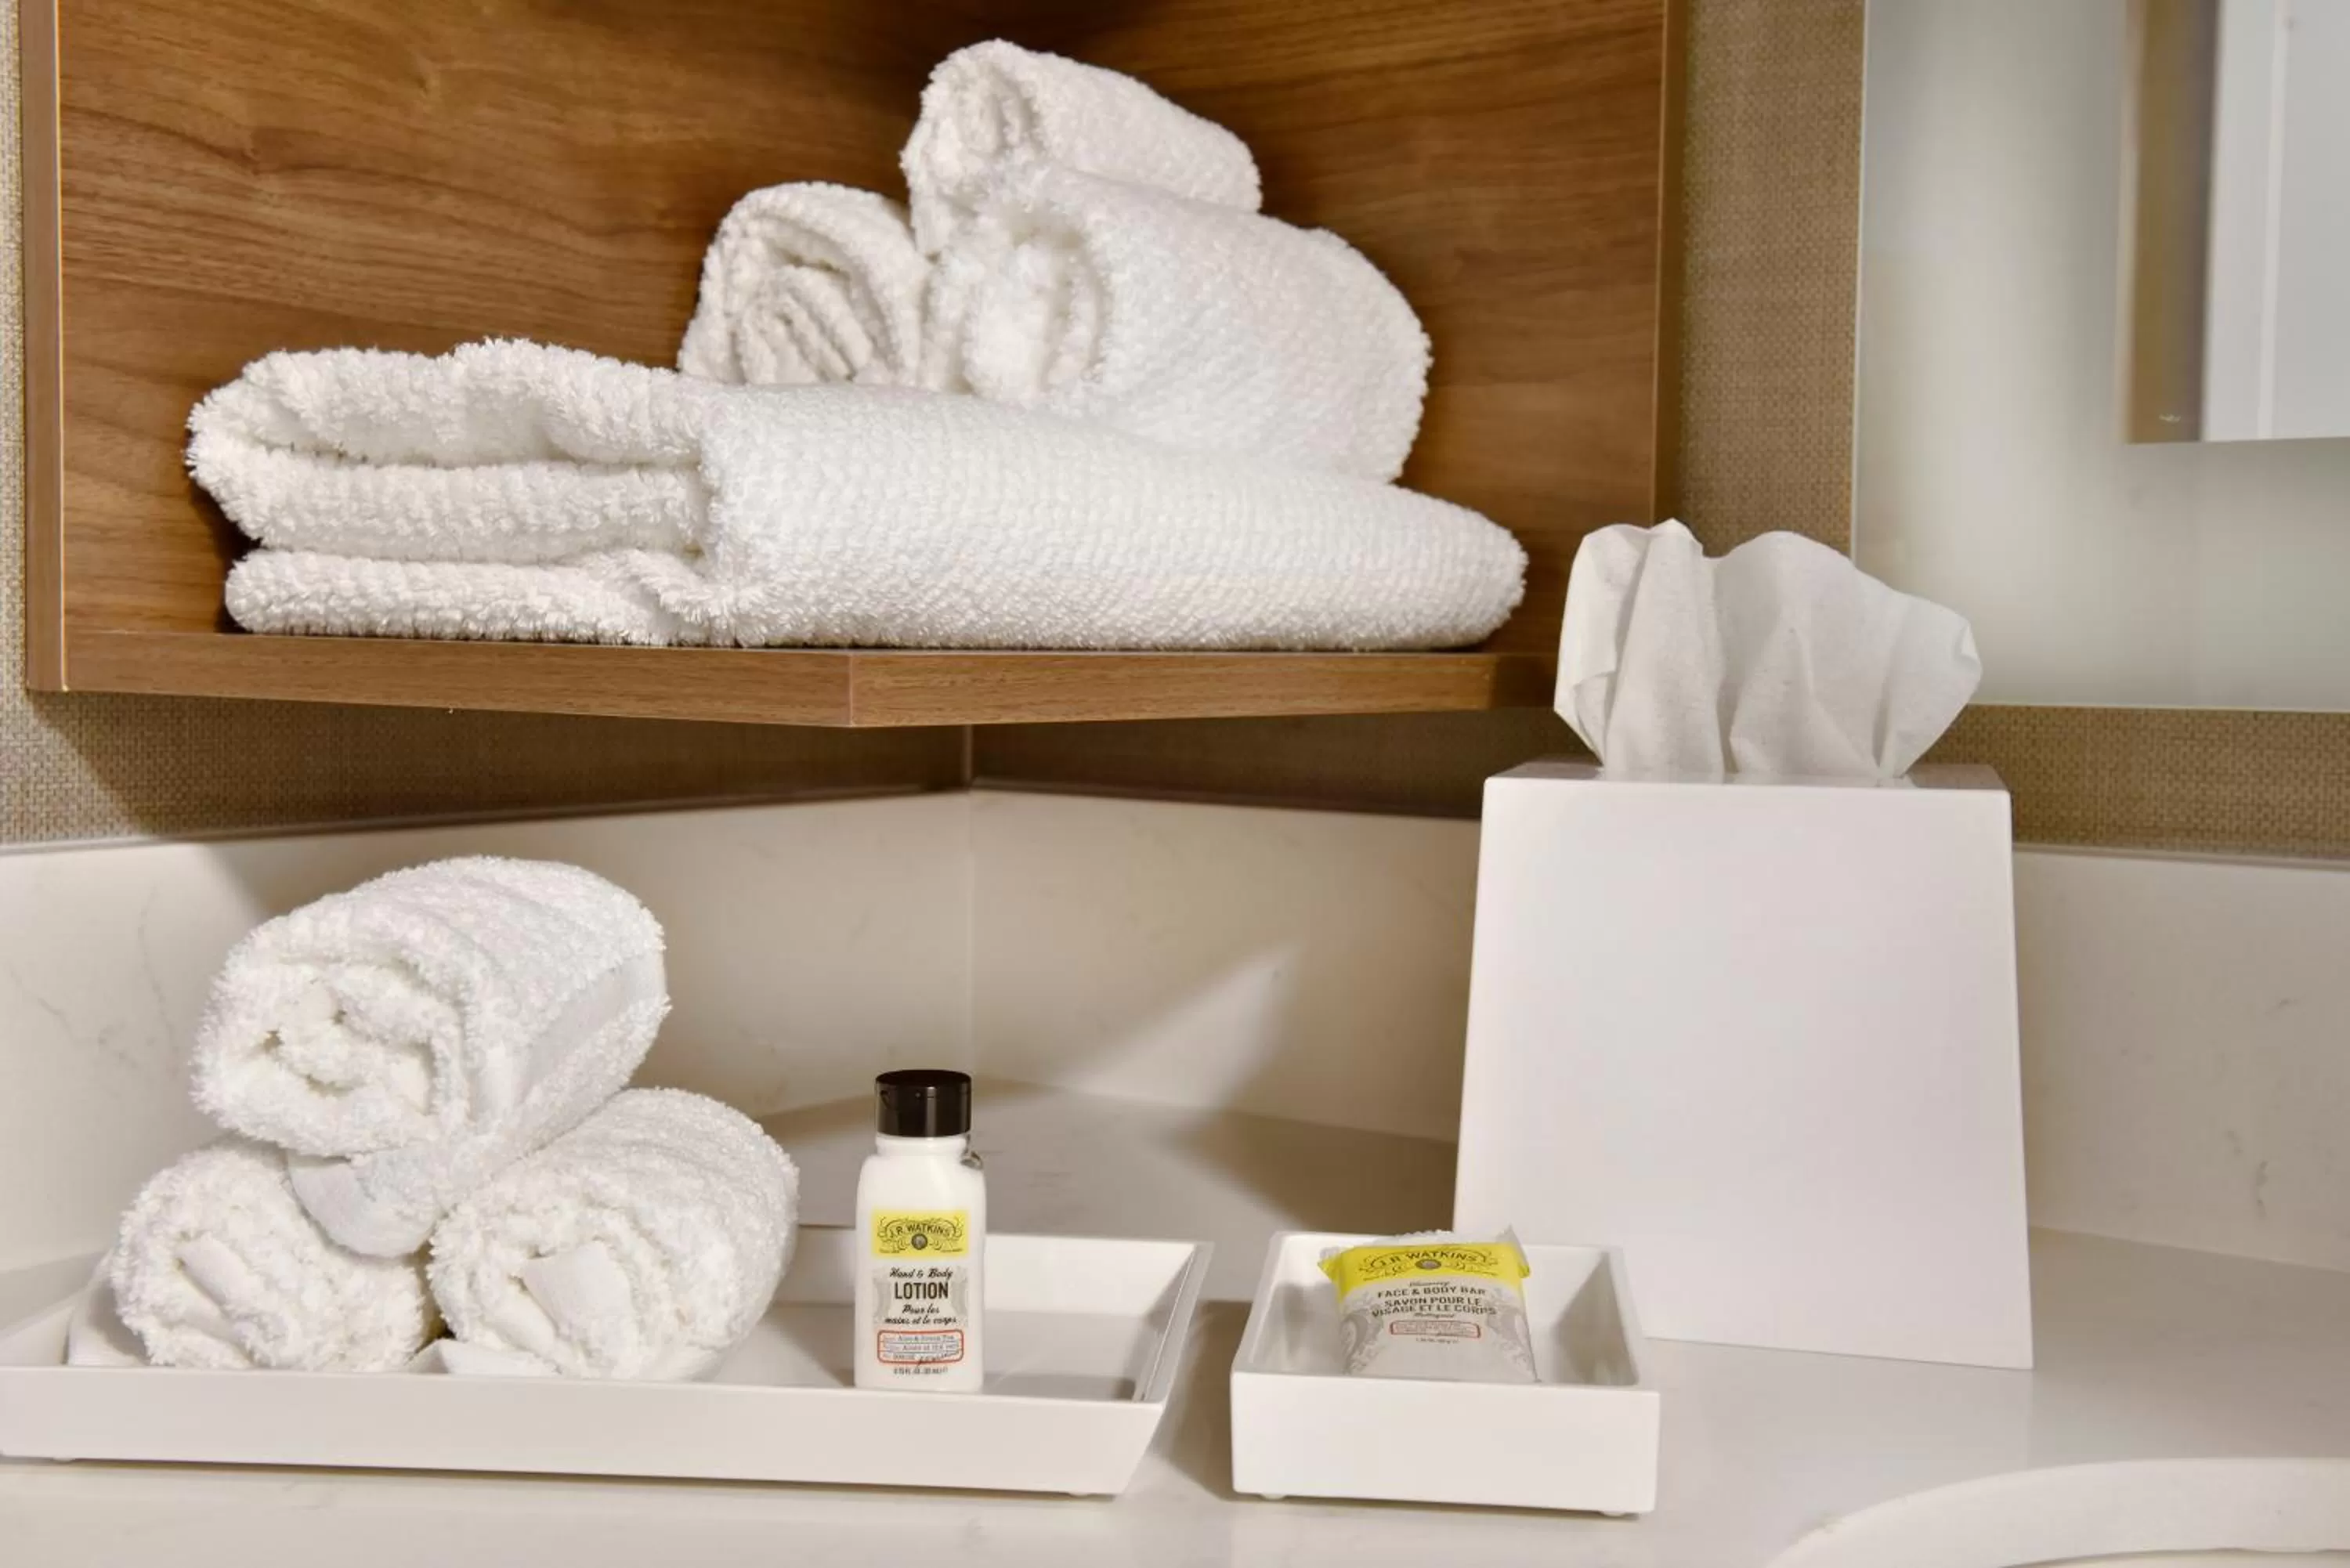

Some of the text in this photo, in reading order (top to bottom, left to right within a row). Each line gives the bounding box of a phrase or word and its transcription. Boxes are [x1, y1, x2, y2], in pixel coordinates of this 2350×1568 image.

[907, 1223, 951, 1237] WATKINS
[1406, 1250, 1477, 1262] WATKINS
[889, 1266, 915, 1278] Hand
[927, 1267, 953, 1279] Body
[895, 1281, 949, 1299] LOTION
[1377, 1288, 1409, 1298] FACE
[1423, 1286, 1457, 1295] BODY
[1461, 1285, 1487, 1295] BAR
[1384, 1297, 1427, 1307] SAVON
[1467, 1296, 1483, 1306] LE
[902, 1304, 925, 1314] Pour
[1371, 1305, 1416, 1317] VISAGE
[1454, 1305, 1498, 1315] CORPS
